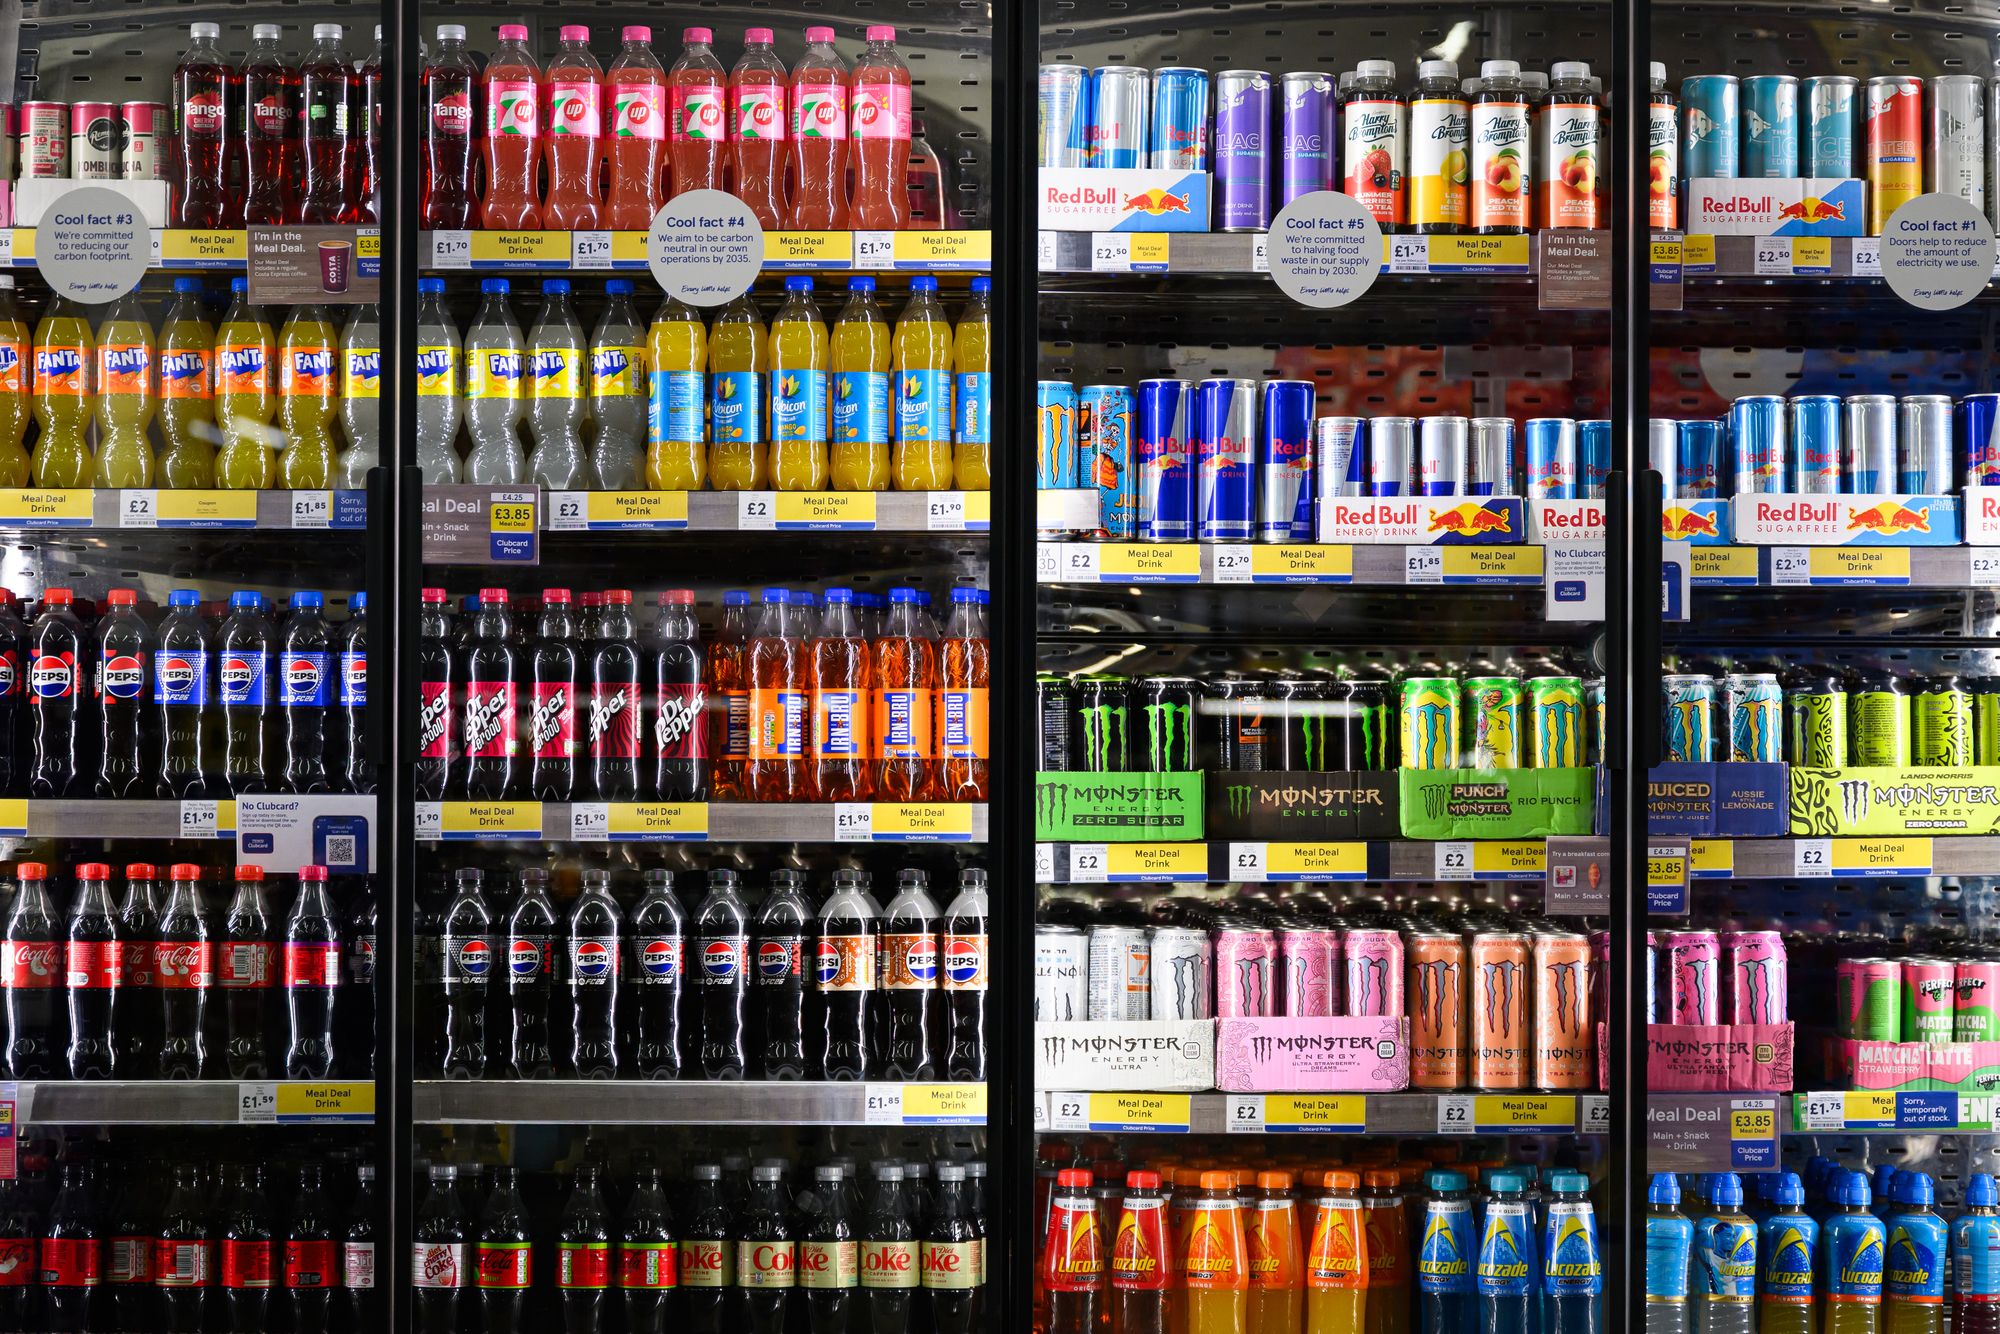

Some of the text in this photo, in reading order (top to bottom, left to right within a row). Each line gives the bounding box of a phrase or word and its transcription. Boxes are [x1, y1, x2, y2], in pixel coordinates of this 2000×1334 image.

[185, 102, 225, 117] Tango
[1048, 188, 1115, 204] Red Bull
[1048, 206, 1116, 214] SUGARFREE
[55, 214, 132, 225] Cool fact #3
[667, 217, 744, 227] Cool fact #4
[1287, 218, 1364, 229] Cool fact #5
[1900, 220, 1975, 231] Cool fact #1
[255, 232, 301, 240] I'm in the
[658, 234, 672, 242] We
[675, 234, 691, 242] aim
[706, 234, 718, 242] be
[721, 234, 753, 242] carbon
[1286, 235, 1364, 244] We're committed
[70, 242, 111, 251] reducing
[437, 242, 467, 253] £1.70
[1890, 238, 1987, 247] Doors help to reduce
[255, 244, 305, 252] Meal Deal.
[700, 244, 707, 252] in
[1292, 246, 1358, 256] to halving food
[1906, 248, 1921, 256] the
[1962, 248, 1971, 256] of
[54, 252, 133, 262] carbon footprint.
[661, 254, 750, 264] operations by 2035.
[1311, 256, 1318, 264] in
[1339, 257, 1369, 266] supply
[1897, 258, 1942, 268] electricity
[329, 256, 337, 283] COSTA
[1292, 266, 1358, 276] chain by 2030.
[772, 398, 806, 415] Rubicon
[502, 494, 523, 502] £4.25
[130, 500, 148, 513] £2
[495, 509, 530, 520] £3.85
[1336, 505, 1417, 524] Red Bull
[1758, 503, 1836, 521] Red Bull
[1336, 528, 1417, 536] ENERGY DRINK
[1757, 524, 1836, 532] SUGARFREE
[497, 540, 528, 548] Clubcard
[1219, 557, 1249, 567] £2.70
[33, 672, 68, 682] PEPSI
[661, 696, 684, 721] Dr
[654, 689, 705, 751] Pepper
[1074, 785, 1184, 803] MONSTER
[1453, 786, 1505, 797] PUNCH
[1874, 785, 1998, 806] MONSTER
[242, 802, 299, 810] No Clubcard?
[1541, 797, 1581, 805] PUNCH
[1722, 801, 1774, 809] LEMONADE
[1449, 803, 1510, 814] MONSTER
[184, 812, 214, 824] £1.90
[1074, 816, 1182, 825] ZERO SUGAR
[578, 954, 607, 963] PEPSI
[1072, 1036, 1181, 1053] MONSTER
[1277, 1035, 1375, 1052] MONSTER
[1655, 1040, 1749, 1057] MONSTER
[1858, 1046, 1973, 1065] MATCHA LATTE
[1858, 1065, 1920, 1074] STRAWBERRY
[331, 1089, 351, 1097] Deal
[243, 1096, 273, 1108] £1.59
[1062, 1104, 1080, 1116] £2
[1810, 1103, 1841, 1115] £1.75
[1904, 1106, 1947, 1116] temporarily
[423, 1249, 447, 1267] cherry
[425, 1256, 454, 1280] Coke
[1546, 1262, 1601, 1276] Lucozade
